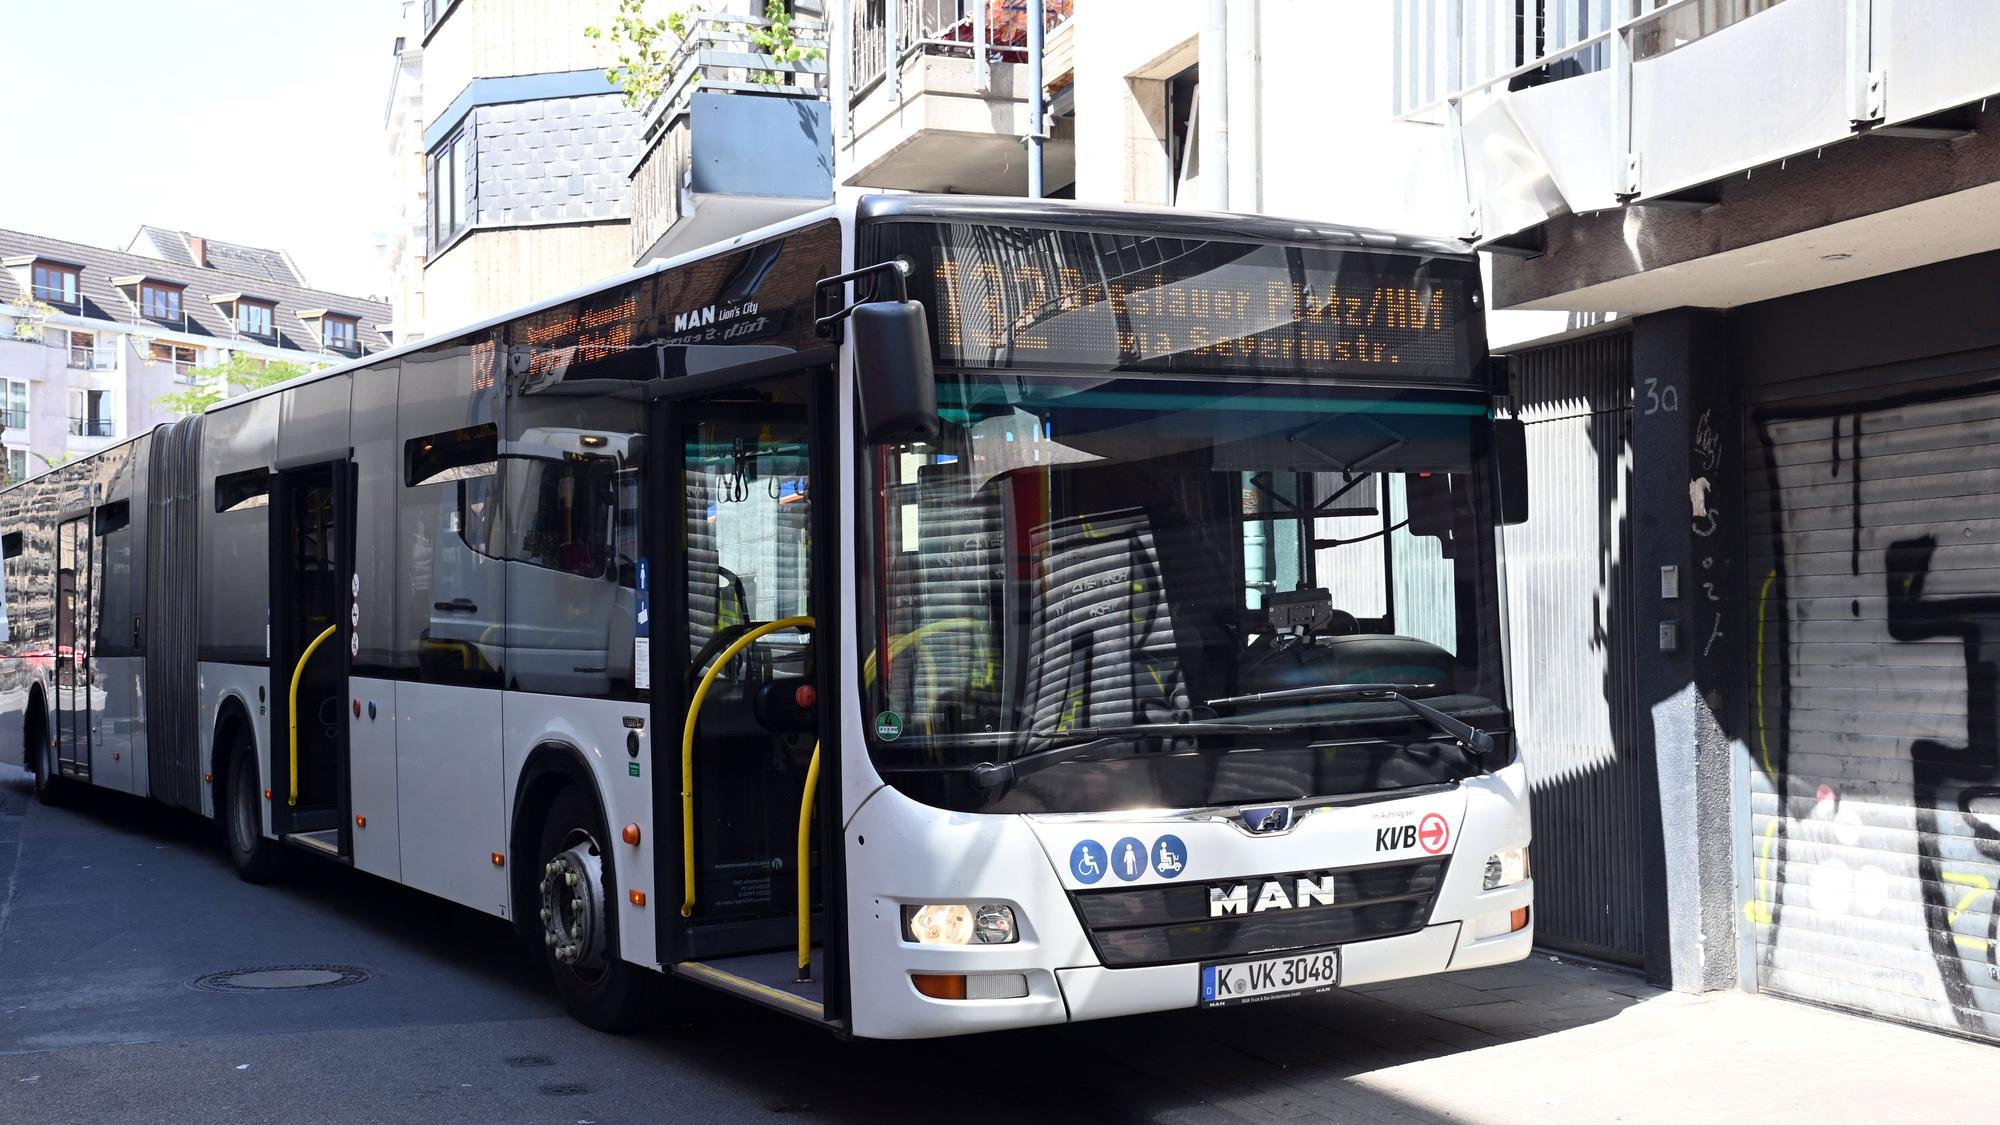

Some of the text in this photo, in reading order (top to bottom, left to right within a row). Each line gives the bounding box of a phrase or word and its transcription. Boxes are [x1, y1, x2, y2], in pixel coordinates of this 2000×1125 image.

[674, 301, 759, 333] MAN Lion's City
[935, 261, 1048, 349] 132
[1059, 268, 1443, 329] Breslauer Platz/Hbf
[1116, 324, 1398, 363] via Severinstr.
[471, 339, 496, 392] 132
[1644, 377, 1678, 415] 3a
[884, 713, 892, 725] 4
[1375, 824, 1417, 852] KVB
[1208, 875, 1335, 918] MAN
[1218, 955, 1333, 995] K VK 3048
